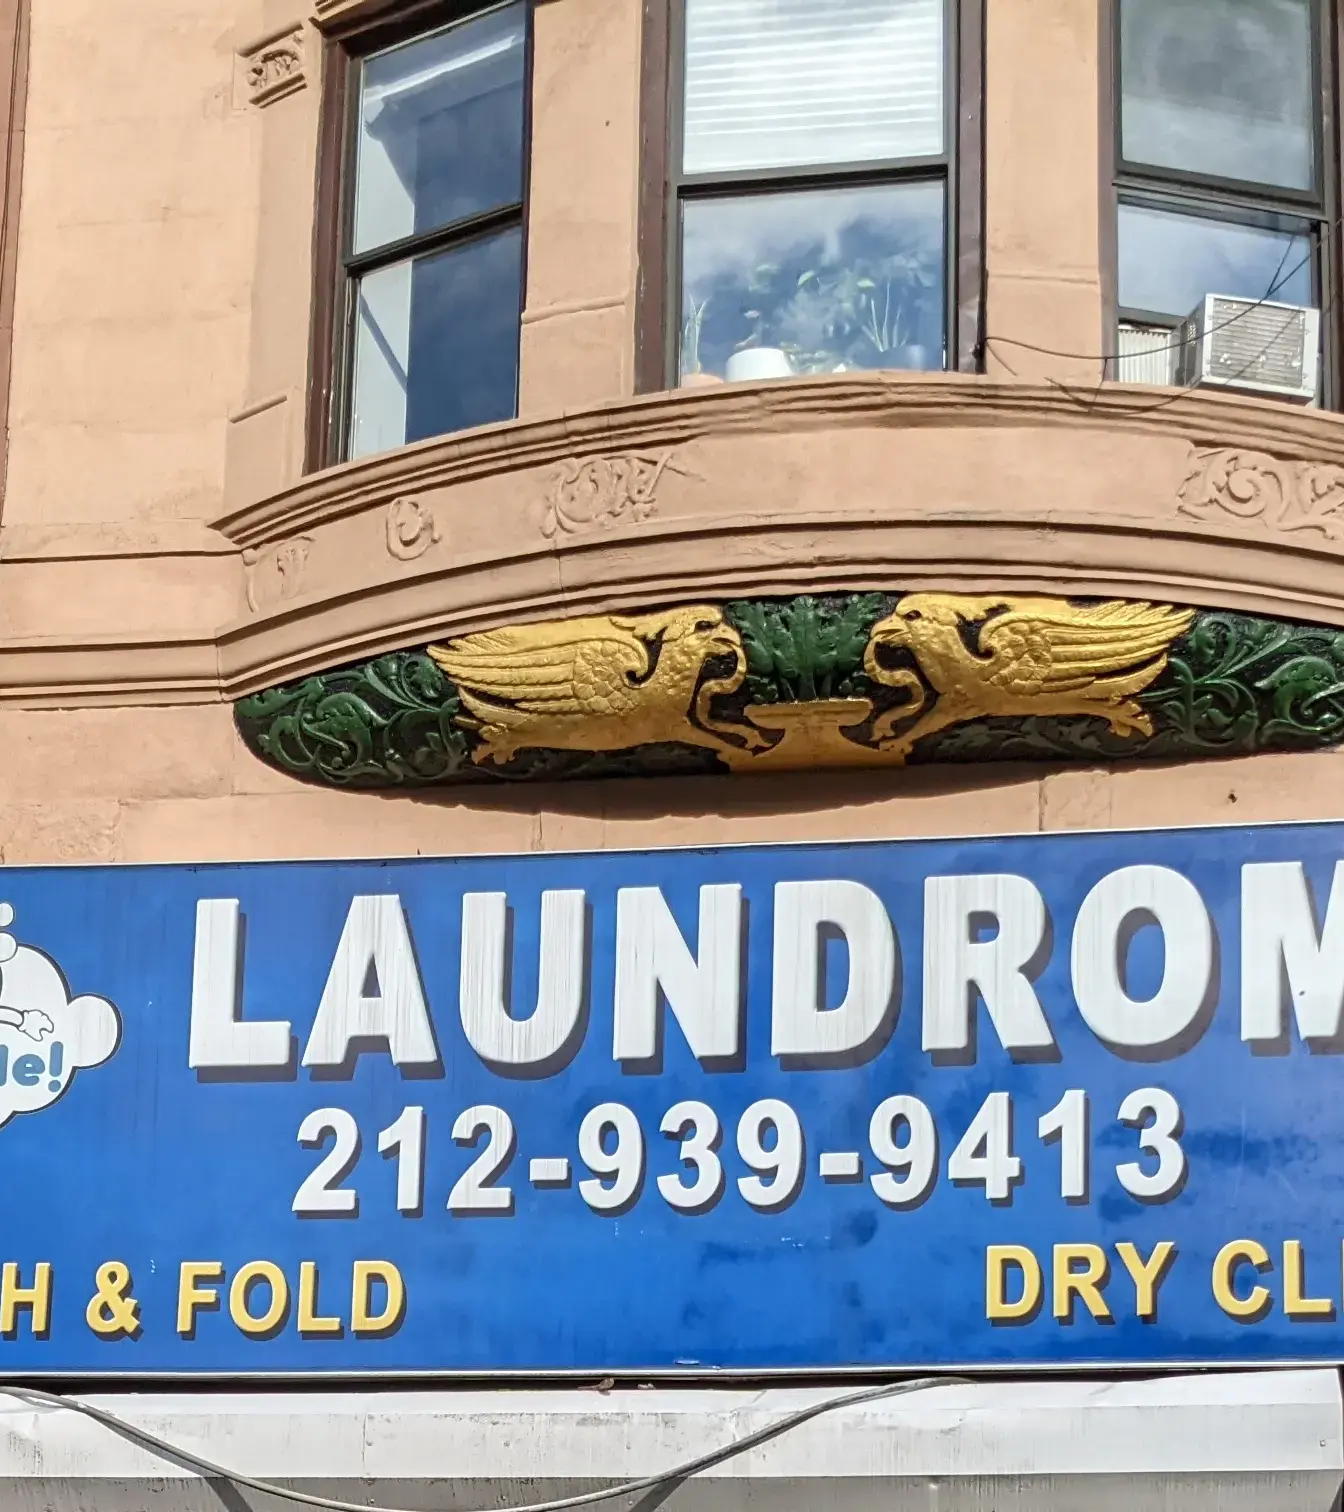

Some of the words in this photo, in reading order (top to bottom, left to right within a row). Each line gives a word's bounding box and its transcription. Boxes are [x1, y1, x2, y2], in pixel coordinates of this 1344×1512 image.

[292, 1088, 1184, 1214] 212-939-9413
[86, 1261, 140, 1334] &
[175, 1260, 405, 1334] FOLD
[986, 1242, 1176, 1321] DRY
